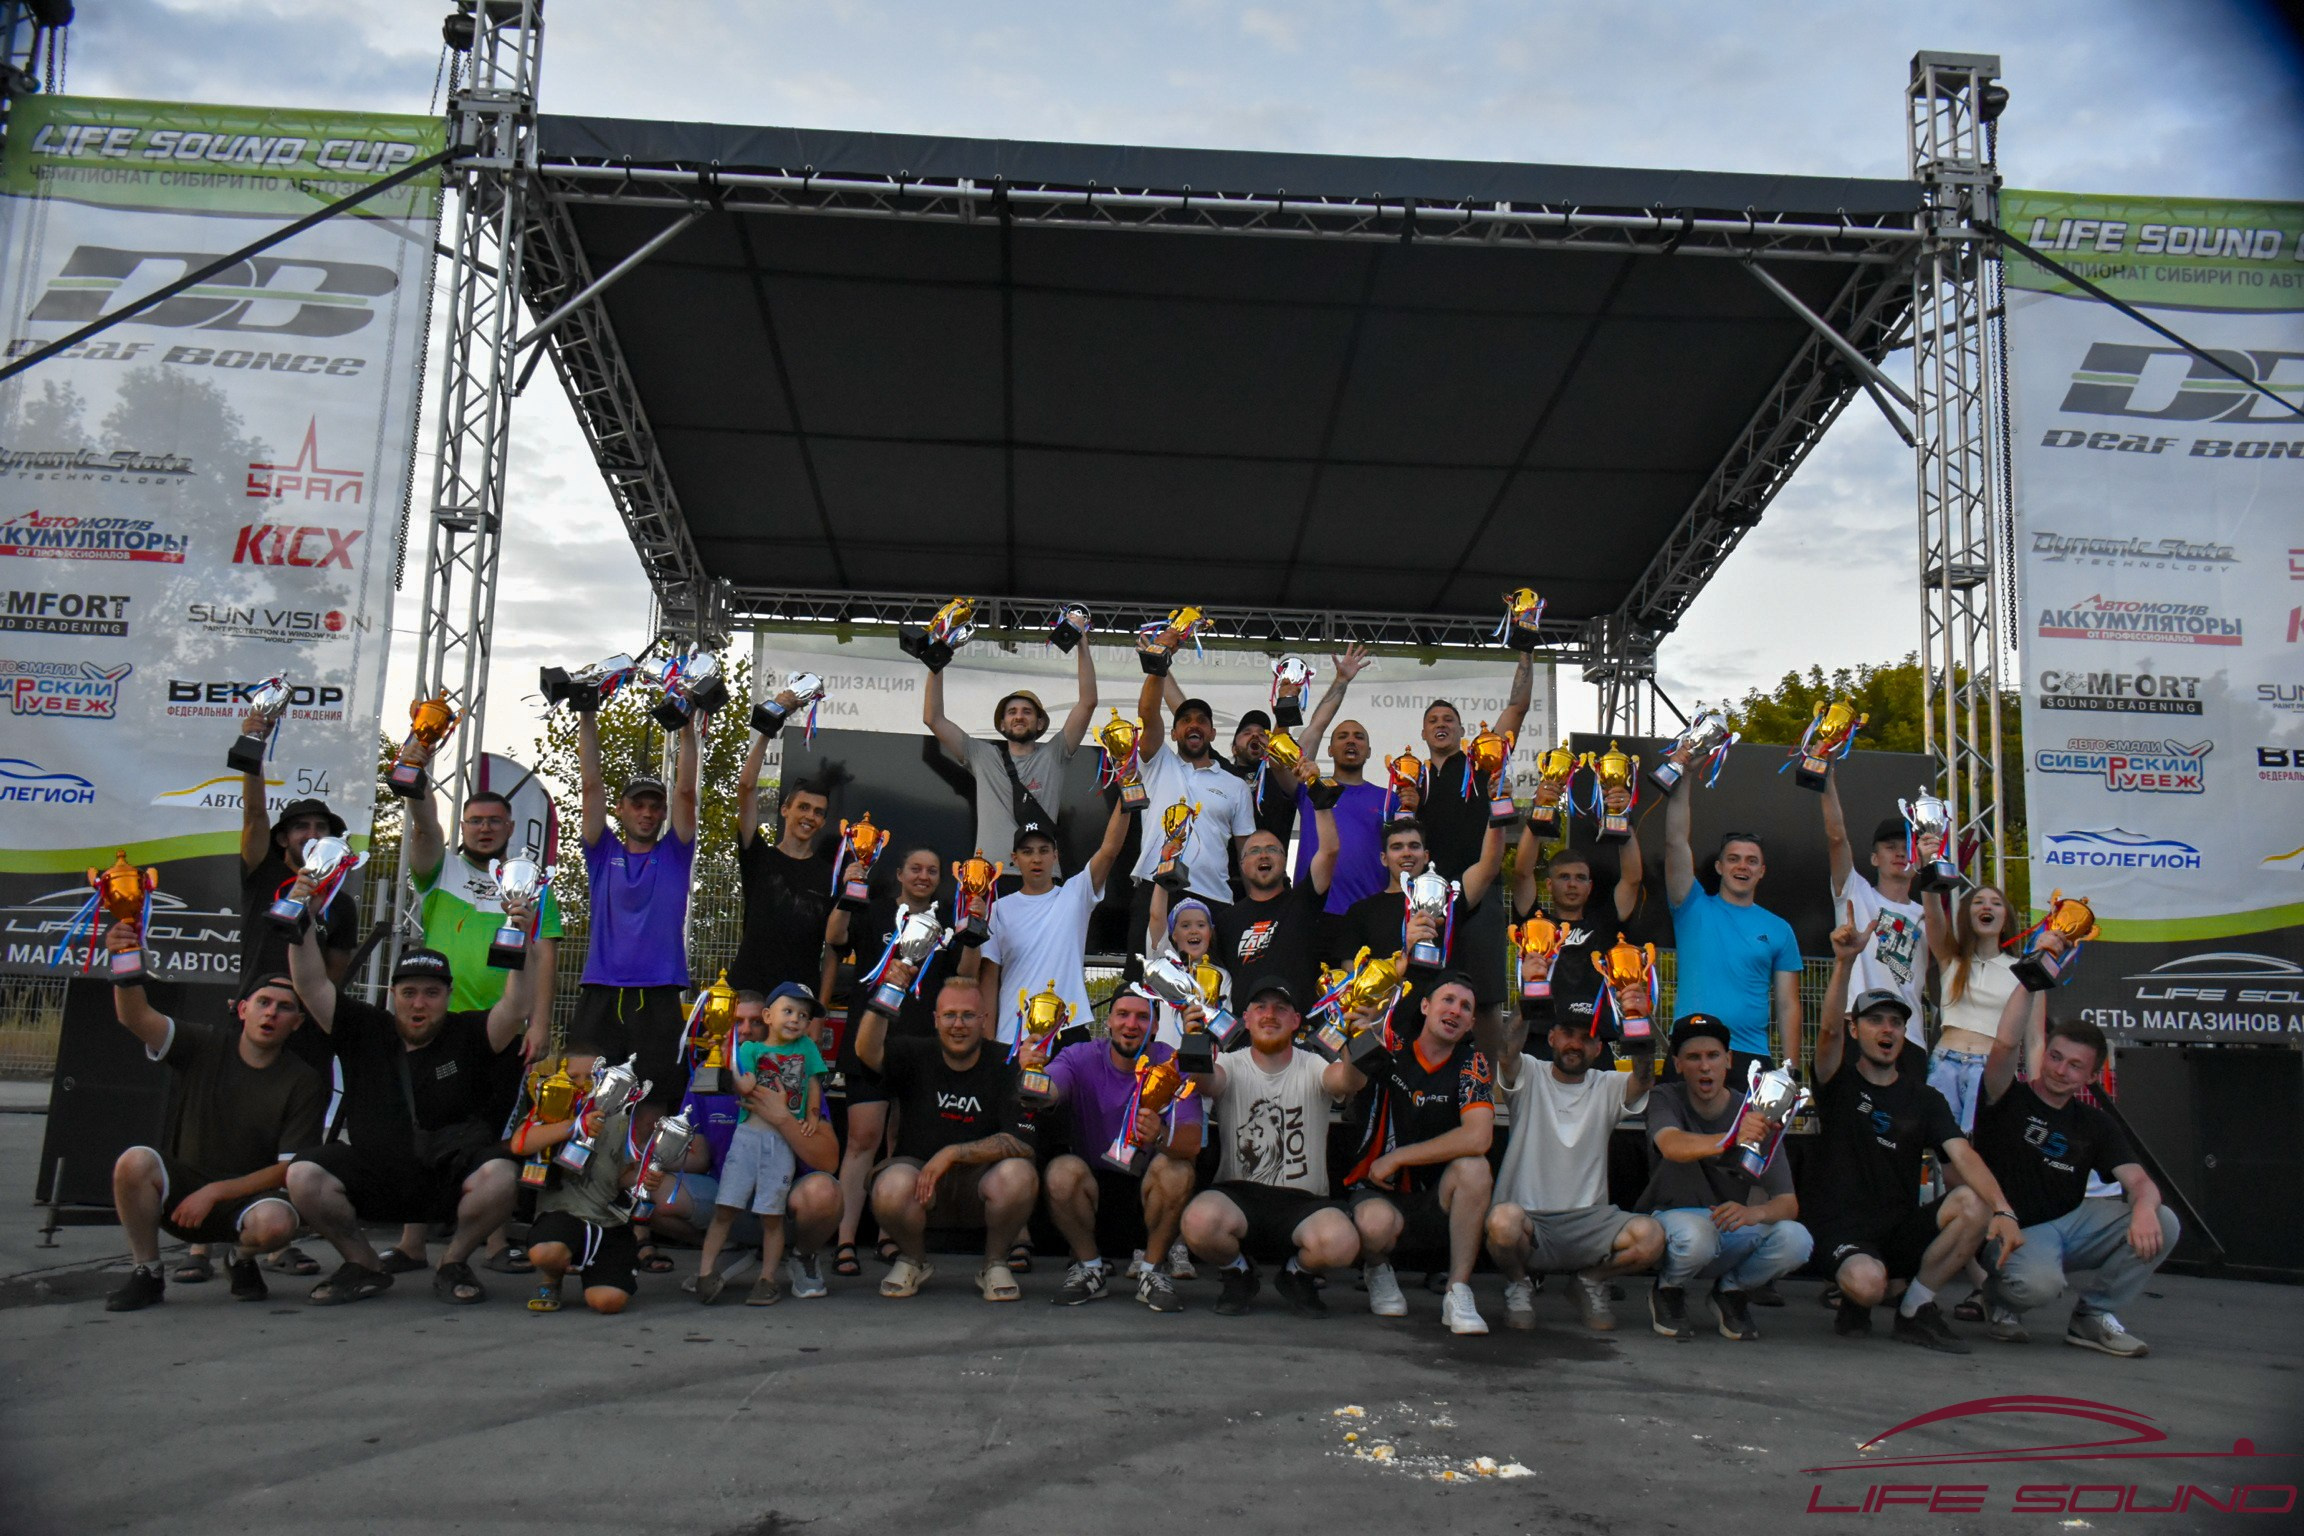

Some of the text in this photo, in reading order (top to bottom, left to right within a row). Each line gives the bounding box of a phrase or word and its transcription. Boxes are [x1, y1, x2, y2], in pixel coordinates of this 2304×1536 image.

[32, 124, 417, 173] LIFE SOUND CUP
[160, 172, 242, 190] СИБИРИ
[251, 176, 278, 192] ПО
[2028, 217, 2128, 253] LIFE
[2135, 223, 2284, 261] SOUND
[2155, 267, 2231, 285] СИБИРИ
[2238, 270, 2263, 287] ПО
[17, 472, 185, 486] TECHNOLOGY
[33, 549, 131, 560] ПРОФЕССИОНАЛОВ
[232, 523, 366, 569] KICX
[2031, 532, 2153, 562] Dynamic
[2074, 557, 2230, 573] TECHNOLOGY
[188, 604, 255, 626] SUN
[2038, 608, 2243, 636] АККУМУЛЯТОРЫ
[24, 620, 121, 634] DEADENING
[2087, 631, 2195, 643] ОТ ПРОФЕССИОНАЛОВ
[168, 679, 344, 707] ВЕКОР
[167, 705, 234, 718] ФЕДЕРАЛЬНАЯ
[291, 709, 343, 721] ВОЖДЕНИЯ
[2046, 697, 2196, 714] SOUND DEADENING
[2067, 738, 2162, 753] АВТОЭМАЛИ
[296, 767, 331, 797] 54
[2045, 850, 2201, 869] АВТОЛЕГИОН
[2136, 986, 2227, 1002] LIFE
[2081, 1008, 2136, 1029] СЕТЬ
[2143, 1010, 2282, 1033] МАГАЗИНОВ
